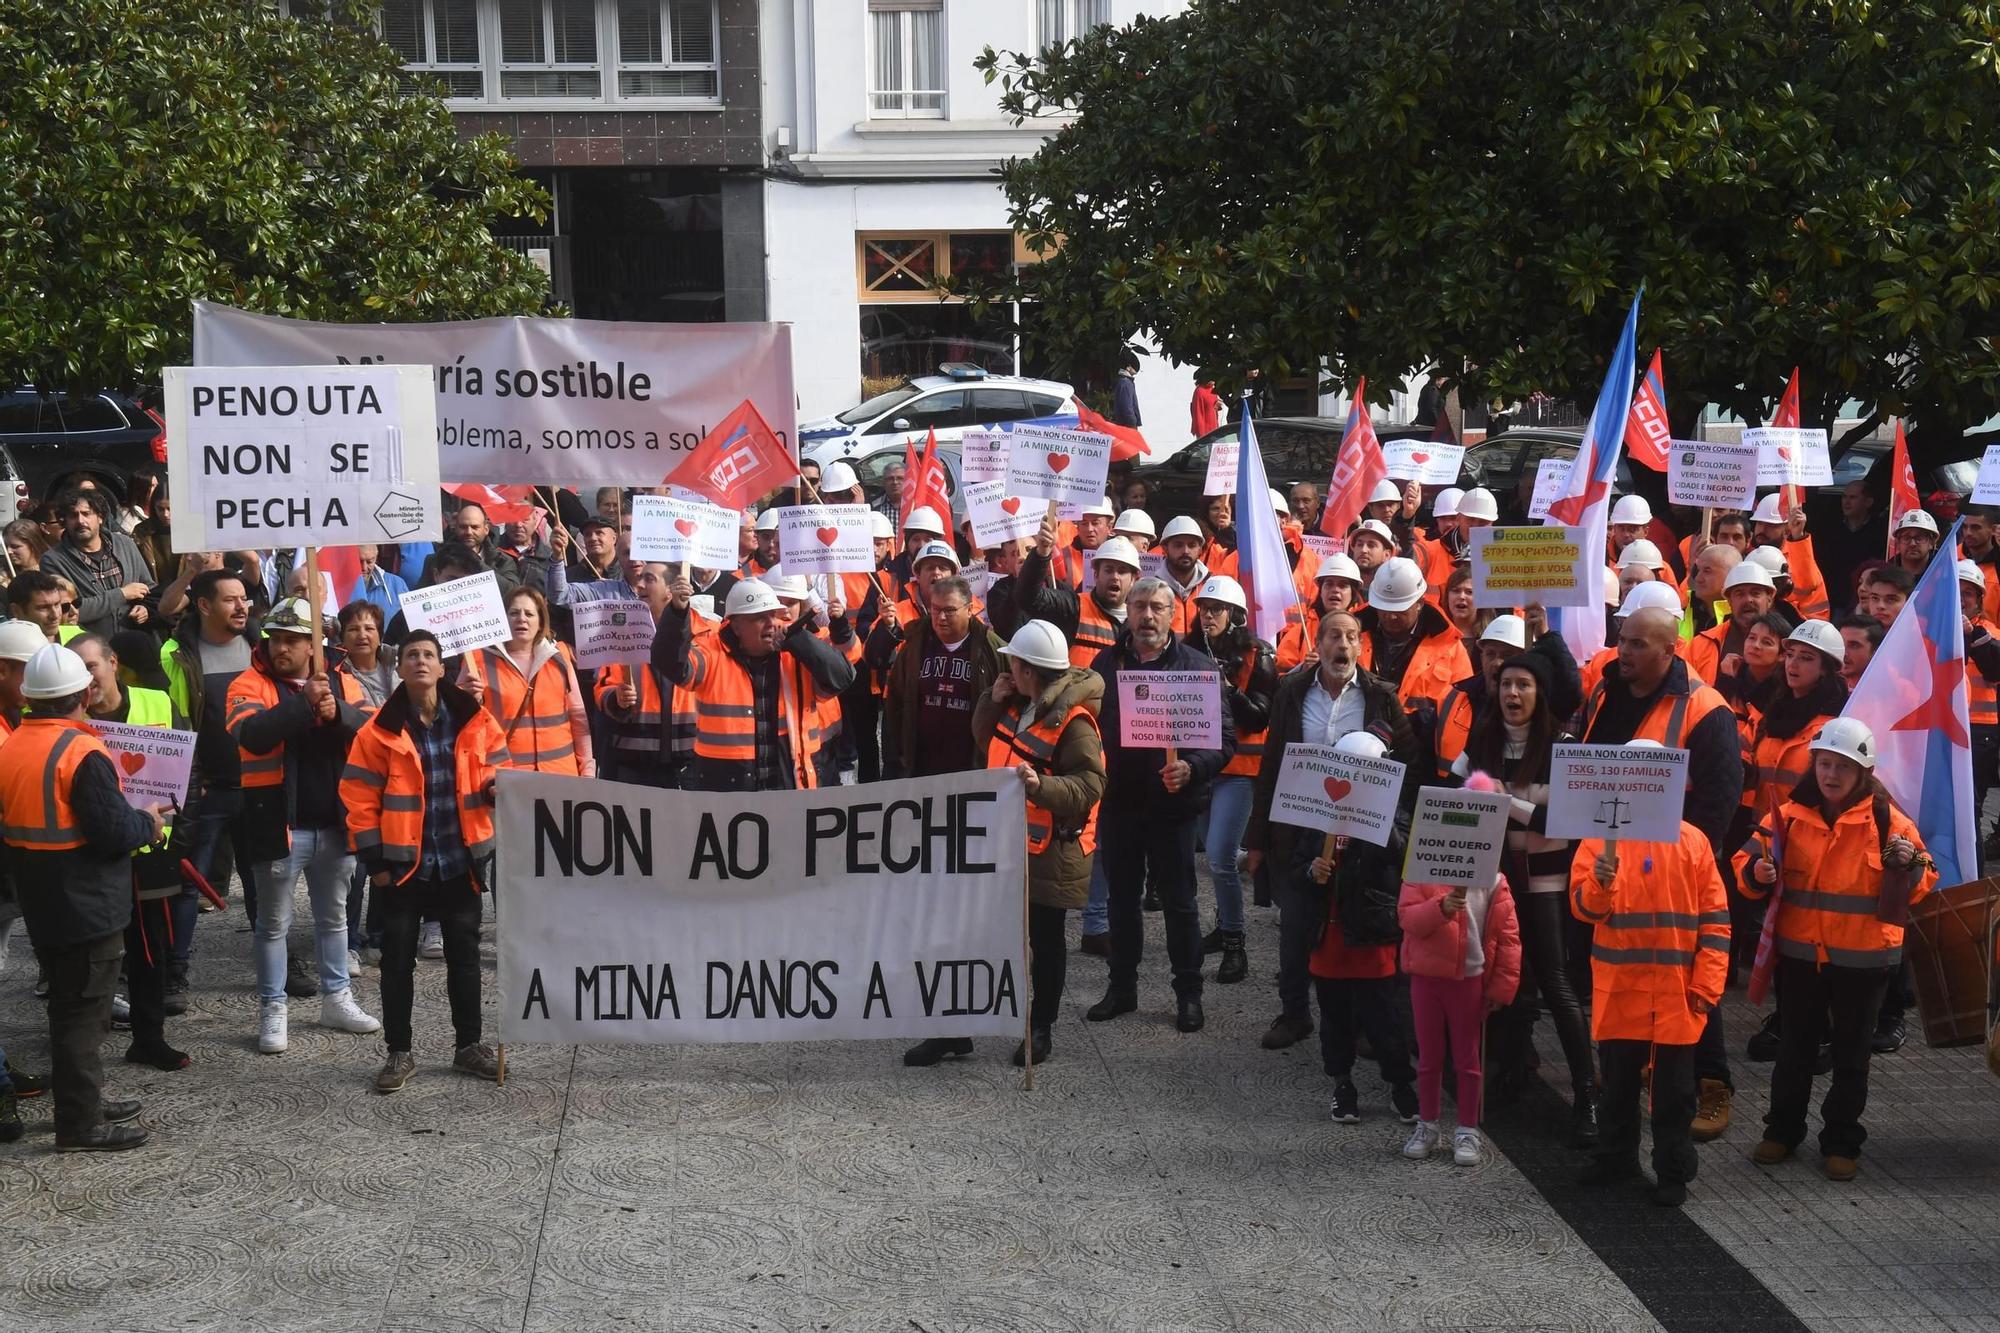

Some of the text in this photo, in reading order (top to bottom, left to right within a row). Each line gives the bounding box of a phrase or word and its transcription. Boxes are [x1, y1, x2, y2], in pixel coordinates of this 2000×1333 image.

[494, 362, 651, 401] sostible
[542, 426, 635, 451] somos
[644, 428, 660, 450] a
[1024, 429, 1042, 437] MINA
[1061, 434, 1109, 447] CONTAMINA!
[1021, 441, 1030, 449] ¡A
[1078, 448, 1102, 458] VIDA!
[1712, 446, 1756, 455] CONTAMINA!
[204, 444, 291, 475] NON
[330, 444, 369, 473] SE
[1696, 461, 1742, 470] ECOLOXETAS
[1026, 471, 1047, 479] FUTURO
[1075, 477, 1096, 485] GALEGO
[973, 482, 1004, 494] MINA NON
[1022, 478, 1096, 493] NOSOS POSTOS TRABALLO
[1696, 494, 1717, 502] RURAL
[687, 504, 736, 520] CONTAMINA!
[706, 519, 730, 530] VIDA!
[788, 522, 797, 530] ¡A
[988, 523, 1021, 535] NOSOS POSTOS
[989, 519, 1007, 527] FUTURO
[1505, 531, 1566, 540] ECOLOXETAS
[1483, 547, 1579, 558] STOP IMPUNIDAD
[1491, 566, 1537, 575] ¡ASUMIDE
[1547, 565, 1573, 573] VOSA
[410, 575, 493, 601] MINA NON CONTAMINA!
[1486, 579, 1577, 588] RESPONSABILIDADE!
[433, 591, 482, 610] ECOLOXETAS
[585, 603, 602, 612] MINA
[472, 617, 501, 631] NA RUA
[493, 629, 506, 638] XA!
[589, 631, 631, 643] ECOLOXETA
[580, 645, 607, 656] QUEREN
[1151, 693, 1204, 702] ECOLOXETAS
[1136, 707, 1164, 715] VERDES
[1131, 720, 1158, 728] CIDADE
[1166, 721, 1196, 729] NEGRO
[117, 726, 192, 743] NON CONTAMINA!
[1131, 733, 1154, 741] NOSO
[1156, 734, 1181, 742] RURAL
[103, 740, 184, 757] MINERIA VIDA!
[1287, 747, 1401, 776] ¡A MINA NON CONTAMINA!
[1555, 749, 1685, 763] ¡A MINA NON CONTAMINA!
[1293, 761, 1392, 789] ¡A MINERIA É VIDA!
[1567, 765, 1671, 777] TSXG, 130 FAMILIAS
[131, 778, 176, 788] RURAL GALEGO
[1568, 781, 1665, 793] ESPERAN XUSTICIA
[1298, 796, 1324, 806] FUTURO
[1334, 805, 1355, 813] RURAL
[1356, 808, 1381, 819] GALEGO
[1425, 799, 1497, 813] QUERO VIVIR
[1292, 804, 1314, 813] NOSOS
[1315, 808, 1338, 820] POSTOS
[1348, 816, 1380, 829] TRABALLO
[534, 792, 996, 880] NON AO PECHE
[1418, 838, 1491, 850] NON QUERO
[1416, 853, 1475, 864] VOLVER A
[1430, 868, 1475, 878] CIDADE
[522, 959, 1018, 1020] A MINA DANOS A VIDA
